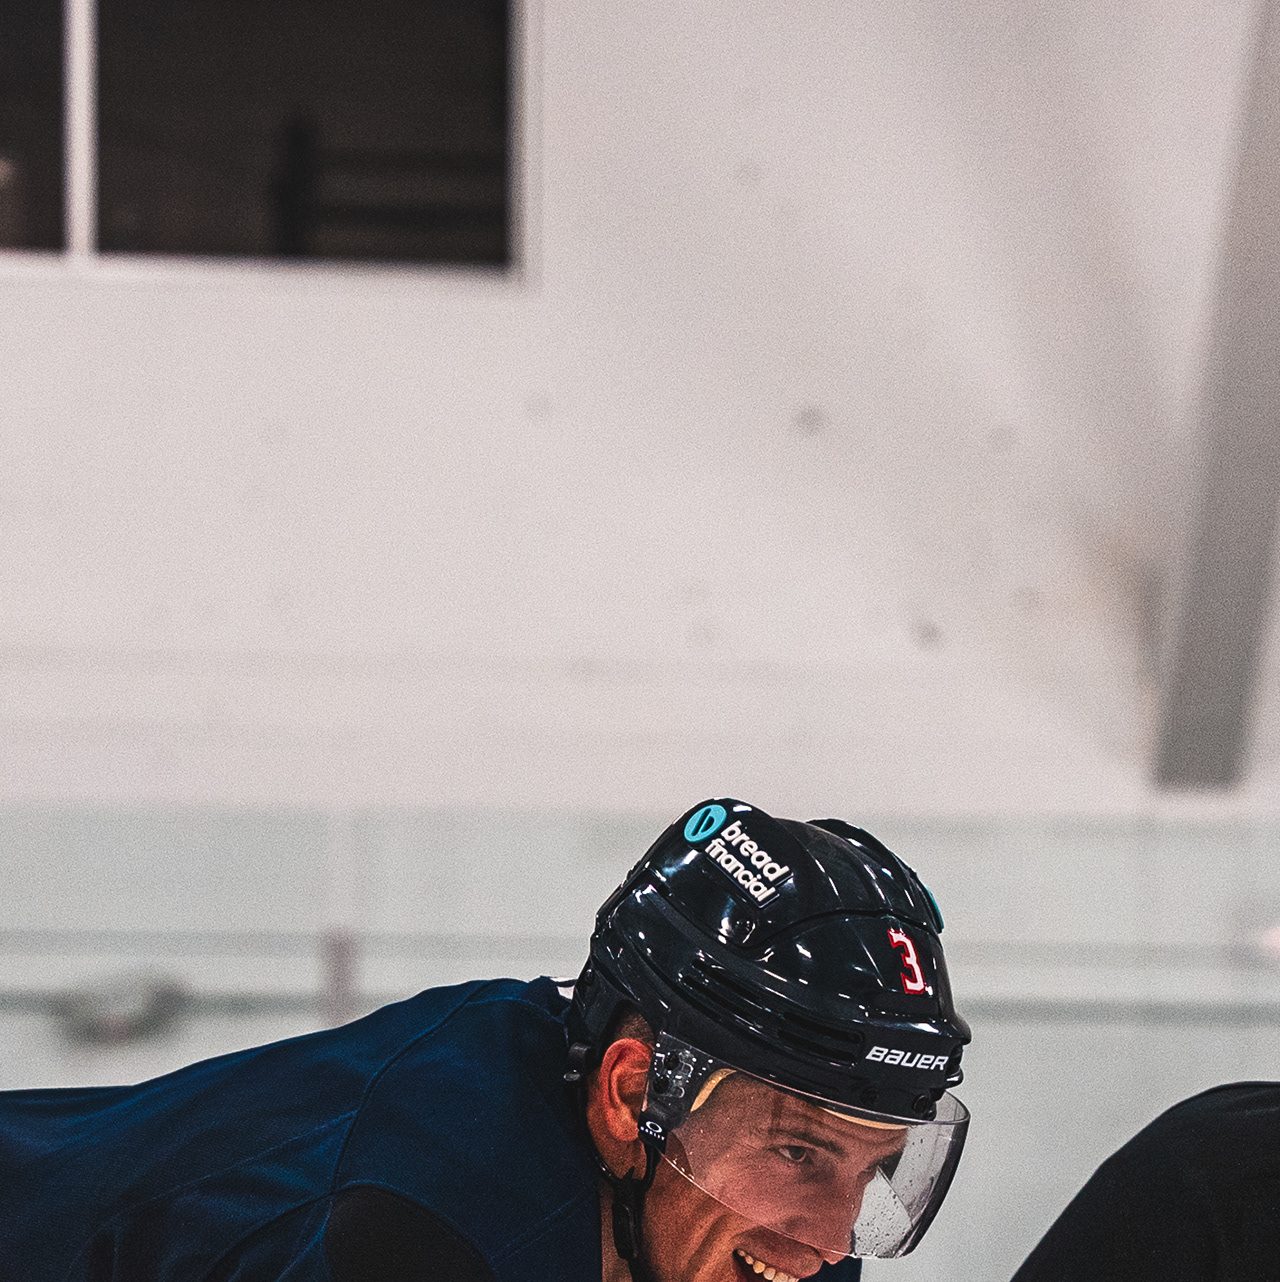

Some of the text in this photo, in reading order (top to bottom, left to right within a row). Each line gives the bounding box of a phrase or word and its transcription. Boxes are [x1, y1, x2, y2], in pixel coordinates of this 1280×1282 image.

[705, 838, 776, 902] financial
[721, 820, 790, 882] bread
[887, 928, 925, 994] 3
[866, 1046, 949, 1071] BAUER
